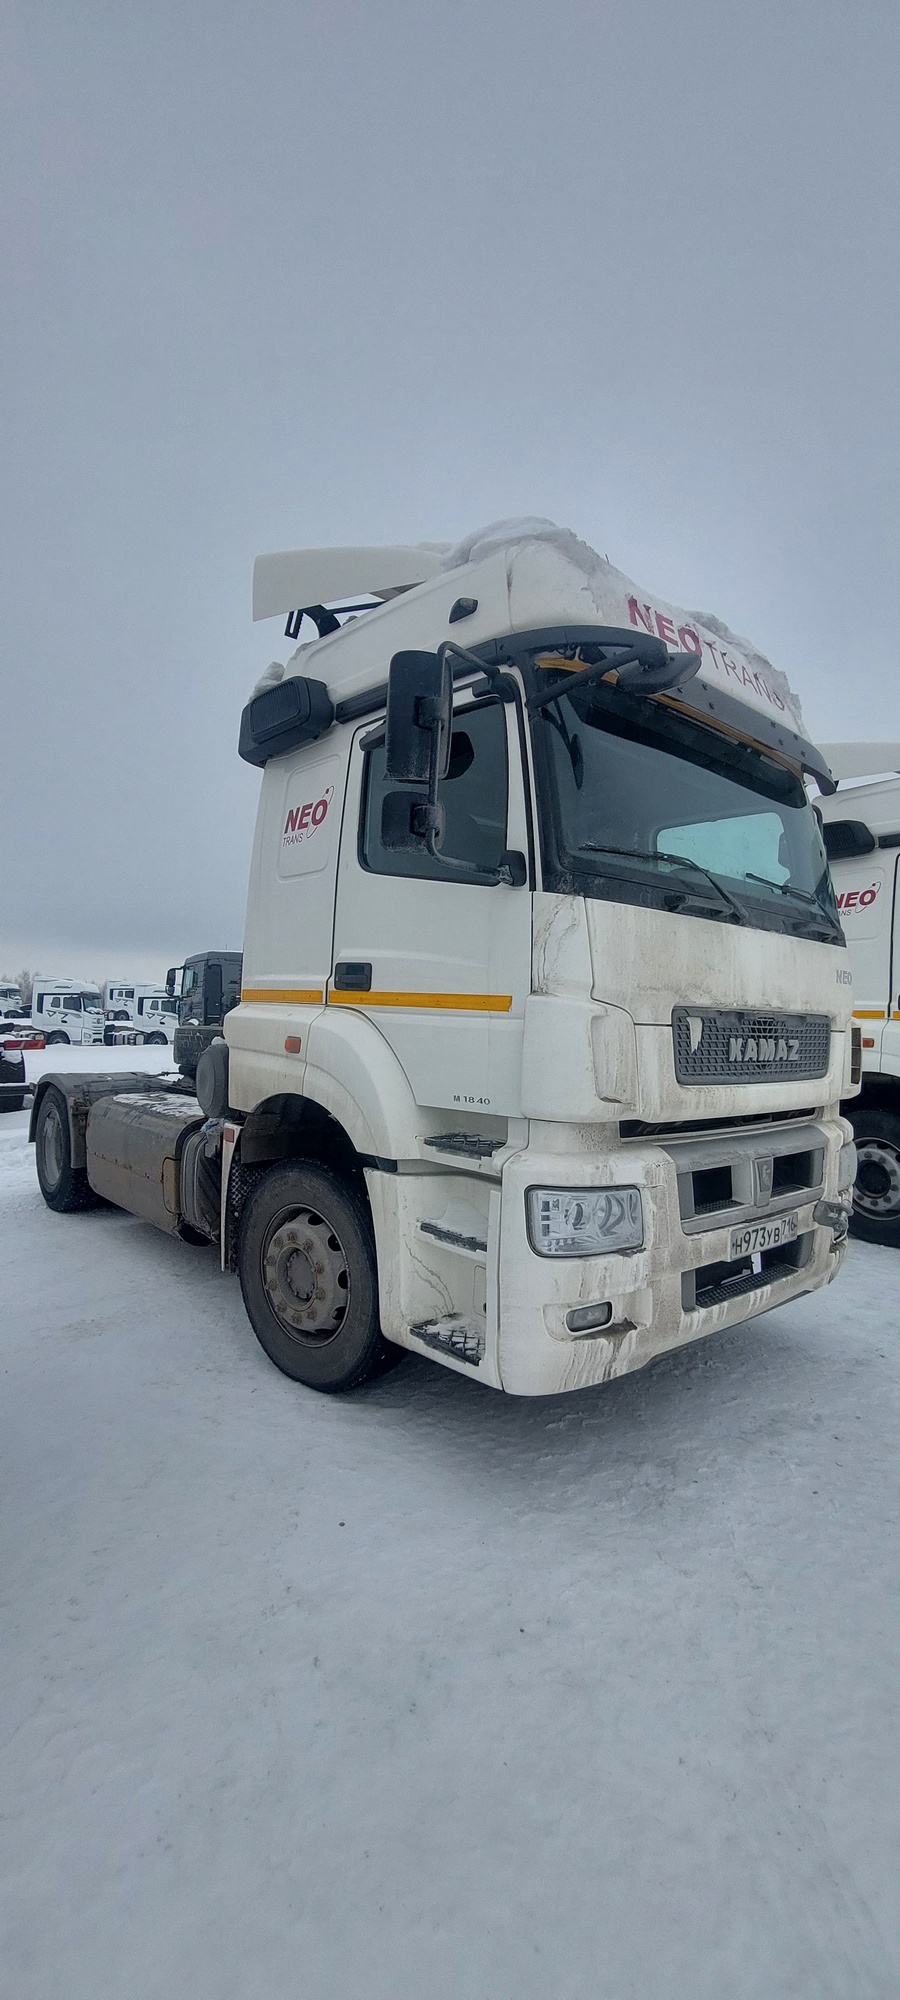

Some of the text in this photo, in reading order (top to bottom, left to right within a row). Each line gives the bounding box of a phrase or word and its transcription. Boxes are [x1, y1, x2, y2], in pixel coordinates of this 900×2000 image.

[627, 595, 702, 658] NEO
[284, 799, 328, 834] NEO
[282, 833, 304, 847] TRANS
[836, 969, 853, 985] NEO
[728, 1037, 800, 1062] KAMAZ
[463, 1095, 491, 1106] 1840
